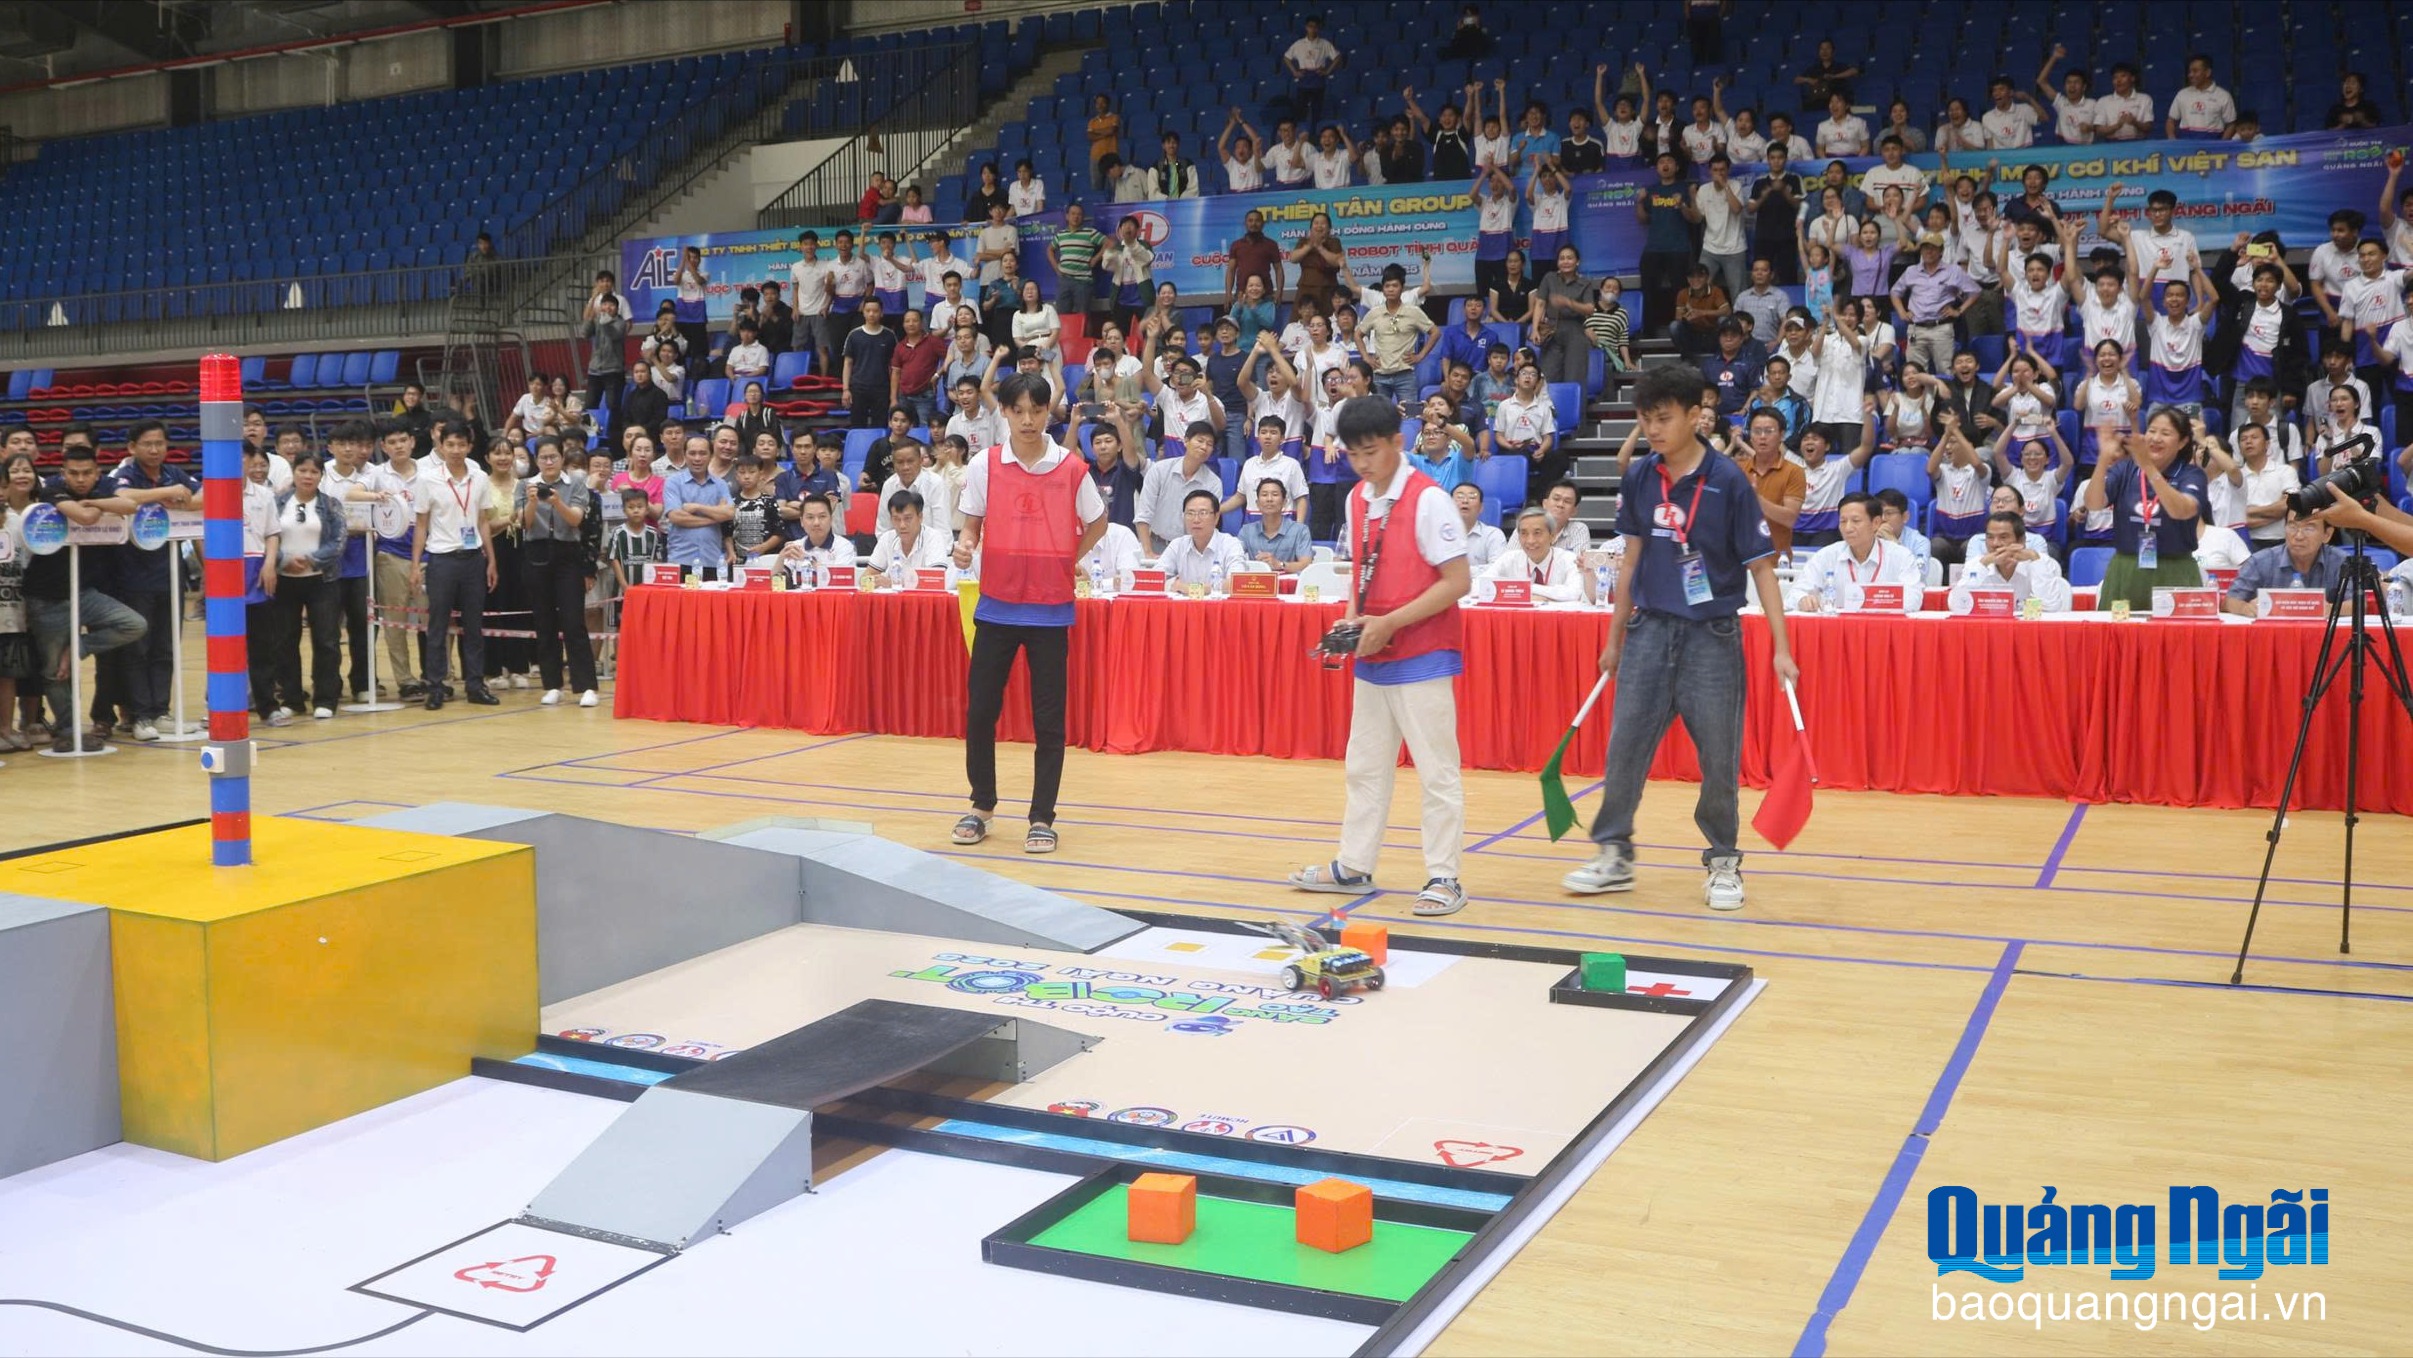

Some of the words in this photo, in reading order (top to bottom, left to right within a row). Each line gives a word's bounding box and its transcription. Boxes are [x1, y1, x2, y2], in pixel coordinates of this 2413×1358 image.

[2068, 160, 2106, 178] CƠ
[2112, 158, 2160, 176] KHÍ
[2168, 151, 2229, 178] VIỆT
[2236, 150, 2298, 169] SAN
[1256, 200, 1326, 222] THIÊN
[1334, 197, 1382, 217] TÂN
[1389, 193, 1473, 214] GROUP
[2222, 196, 2275, 215] NGÃI
[1377, 221, 1411, 233] HÀNH
[1347, 245, 1400, 258] ROBOT
[932, 952, 1051, 970] 2025
[1057, 966, 1178, 986] NGÃI
[993, 996, 1058, 1010] THI
[1062, 1003, 1169, 1021] CUỘC
[1258, 1002, 1341, 1018] TẠO
[1222, 1007, 1332, 1024] SÁNG
